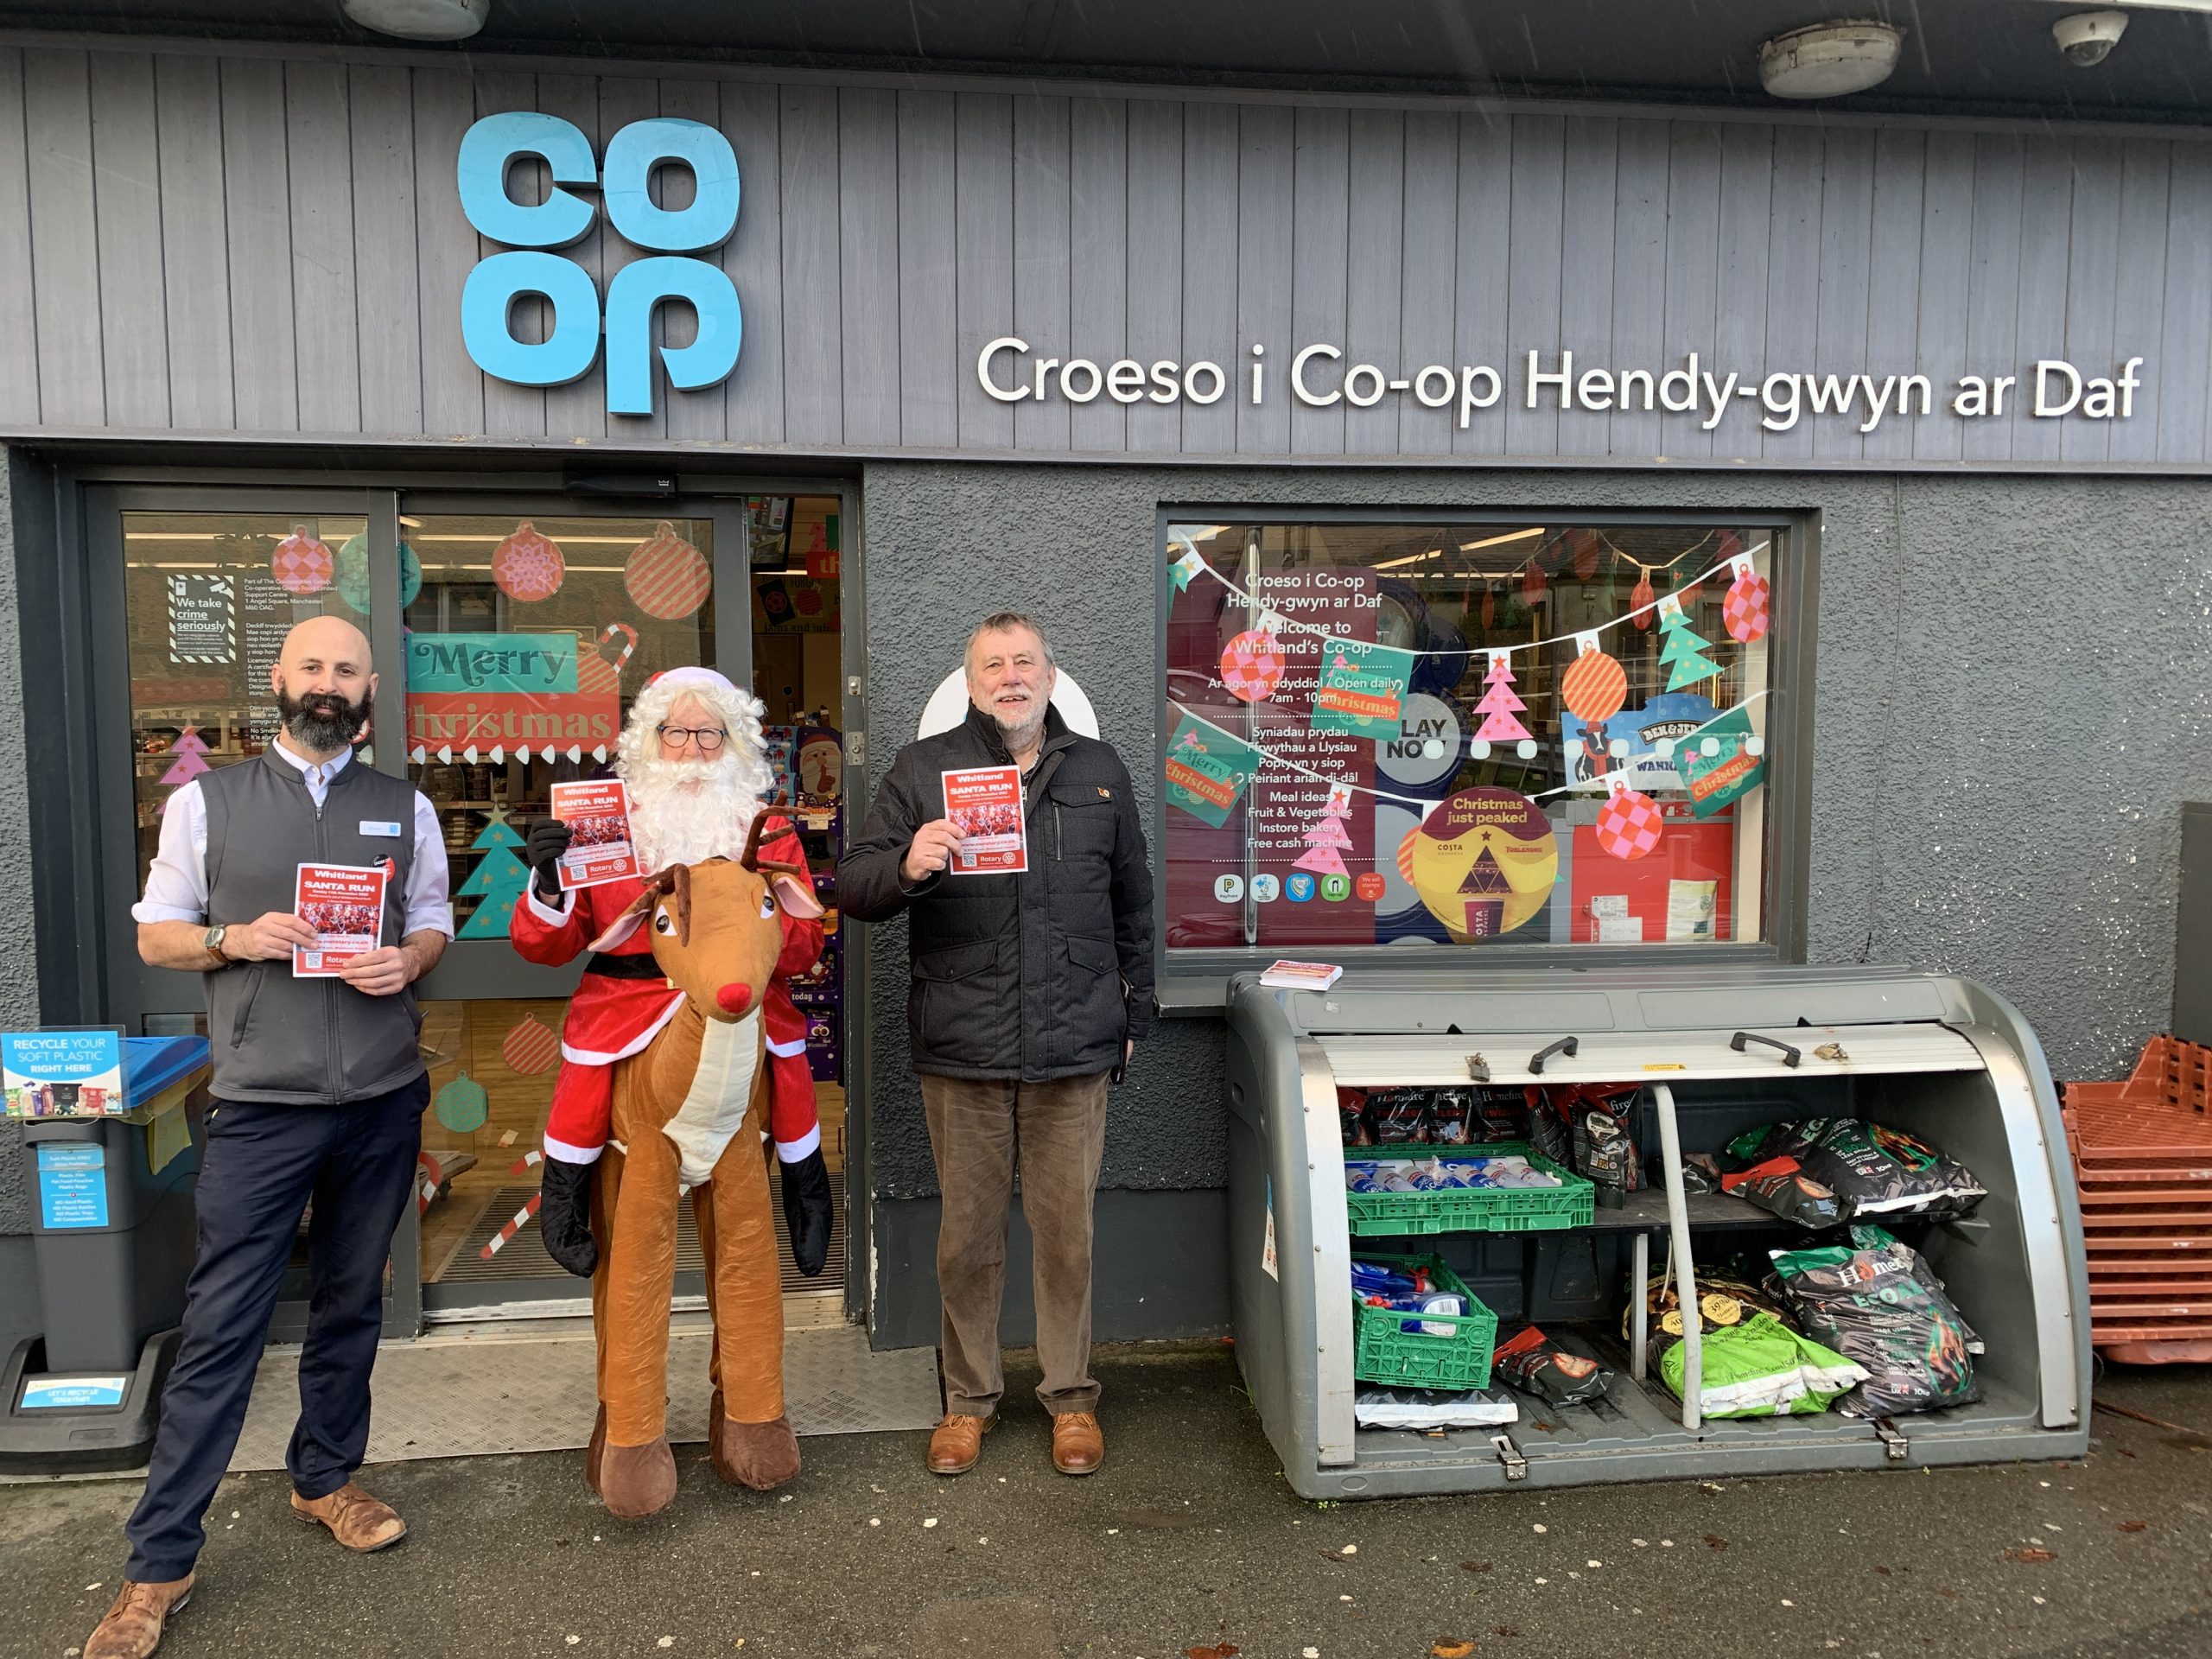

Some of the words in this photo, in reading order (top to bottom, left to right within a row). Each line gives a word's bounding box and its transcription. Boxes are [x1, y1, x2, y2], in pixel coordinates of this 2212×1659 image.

[978, 338, 1225, 404] Croeso
[1252, 344, 1264, 404] i
[1291, 344, 1501, 429] Co-op
[1528, 349, 1931, 432] Hendy-gwyn
[1955, 374, 2015, 416] ar
[2035, 357, 2144, 417] Daf
[1245, 573, 1302, 588] Croeso
[1306, 573, 1311, 588] i
[1315, 574, 1364, 592] Co-op
[176, 598, 195, 607] We
[198, 598, 222, 607] take
[1227, 593, 1329, 612] Hendy-gwyn
[1334, 596, 1350, 607] ar
[1354, 593, 1382, 608] Daf
[176, 609, 208, 619] crime
[177, 620, 226, 633] seriously
[1335, 621, 1351, 634] to
[1323, 642, 1372, 660] Co-op
[415, 643, 568, 687] Merry
[1208, 677, 1223, 688] Ar
[1224, 678, 1249, 692] agor
[1251, 679, 1268, 691] yn
[1271, 677, 1324, 691] ddyddiol
[1334, 677, 1367, 690] Open
[1370, 677, 1397, 690] daily
[1269, 692, 1294, 703] 7am
[1304, 692, 1336, 706] 10pm
[1253, 726, 1305, 741] Syniadau
[1308, 726, 1349, 741] prydau
[1401, 719, 1446, 738] LAY
[1319, 741, 1357, 755] Llysiau
[1182, 747, 1227, 779] Merry
[1258, 757, 1291, 771] Popty
[1310, 760, 1319, 771] y
[1320, 758, 1345, 771] siop
[1694, 745, 1735, 773] Merry
[957, 772, 1003, 783] Whitland
[1248, 772, 1292, 784] Peiriant
[1694, 755, 1756, 797] Christmas
[950, 785, 987, 795] SANTA
[988, 783, 1013, 791] RUN
[1166, 762, 1230, 804] Christmas
[564, 786, 608, 796] Whitland
[1269, 791, 1298, 802] Meal
[1300, 791, 1331, 802] ideas
[557, 798, 593, 808] SANTA
[594, 796, 618, 804] RUN
[1452, 798, 1524, 810] Christmas
[1248, 807, 1274, 817] Fruit
[1277, 808, 1286, 817] &
[1289, 807, 1353, 820] Vegetables
[1446, 811, 1474, 825] just
[1476, 811, 1528, 826] peaked
[1259, 823, 1299, 833] Instore
[1301, 822, 1341, 836] bakery
[1247, 838, 1274, 848] Free
[1275, 837, 1301, 848] cash
[1304, 837, 1352, 849] machine
[1438, 843, 1463, 852] COSTA
[315, 870, 366, 880] Whitland
[304, 880, 346, 891] SANTA
[348, 884, 375, 893] RUN
[1475, 910, 1484, 936] OSTA
[14, 1039, 68, 1049] RECYCLE
[71, 1039, 105, 1048] YOUR
[18, 1052, 48, 1062] SOFT
[54, 1051, 103, 1062] PLASTIC
[30, 1065, 63, 1073] RIGHT
[65, 1064, 92, 1072] HERE
[1610, 1099, 1630, 1110] fire
